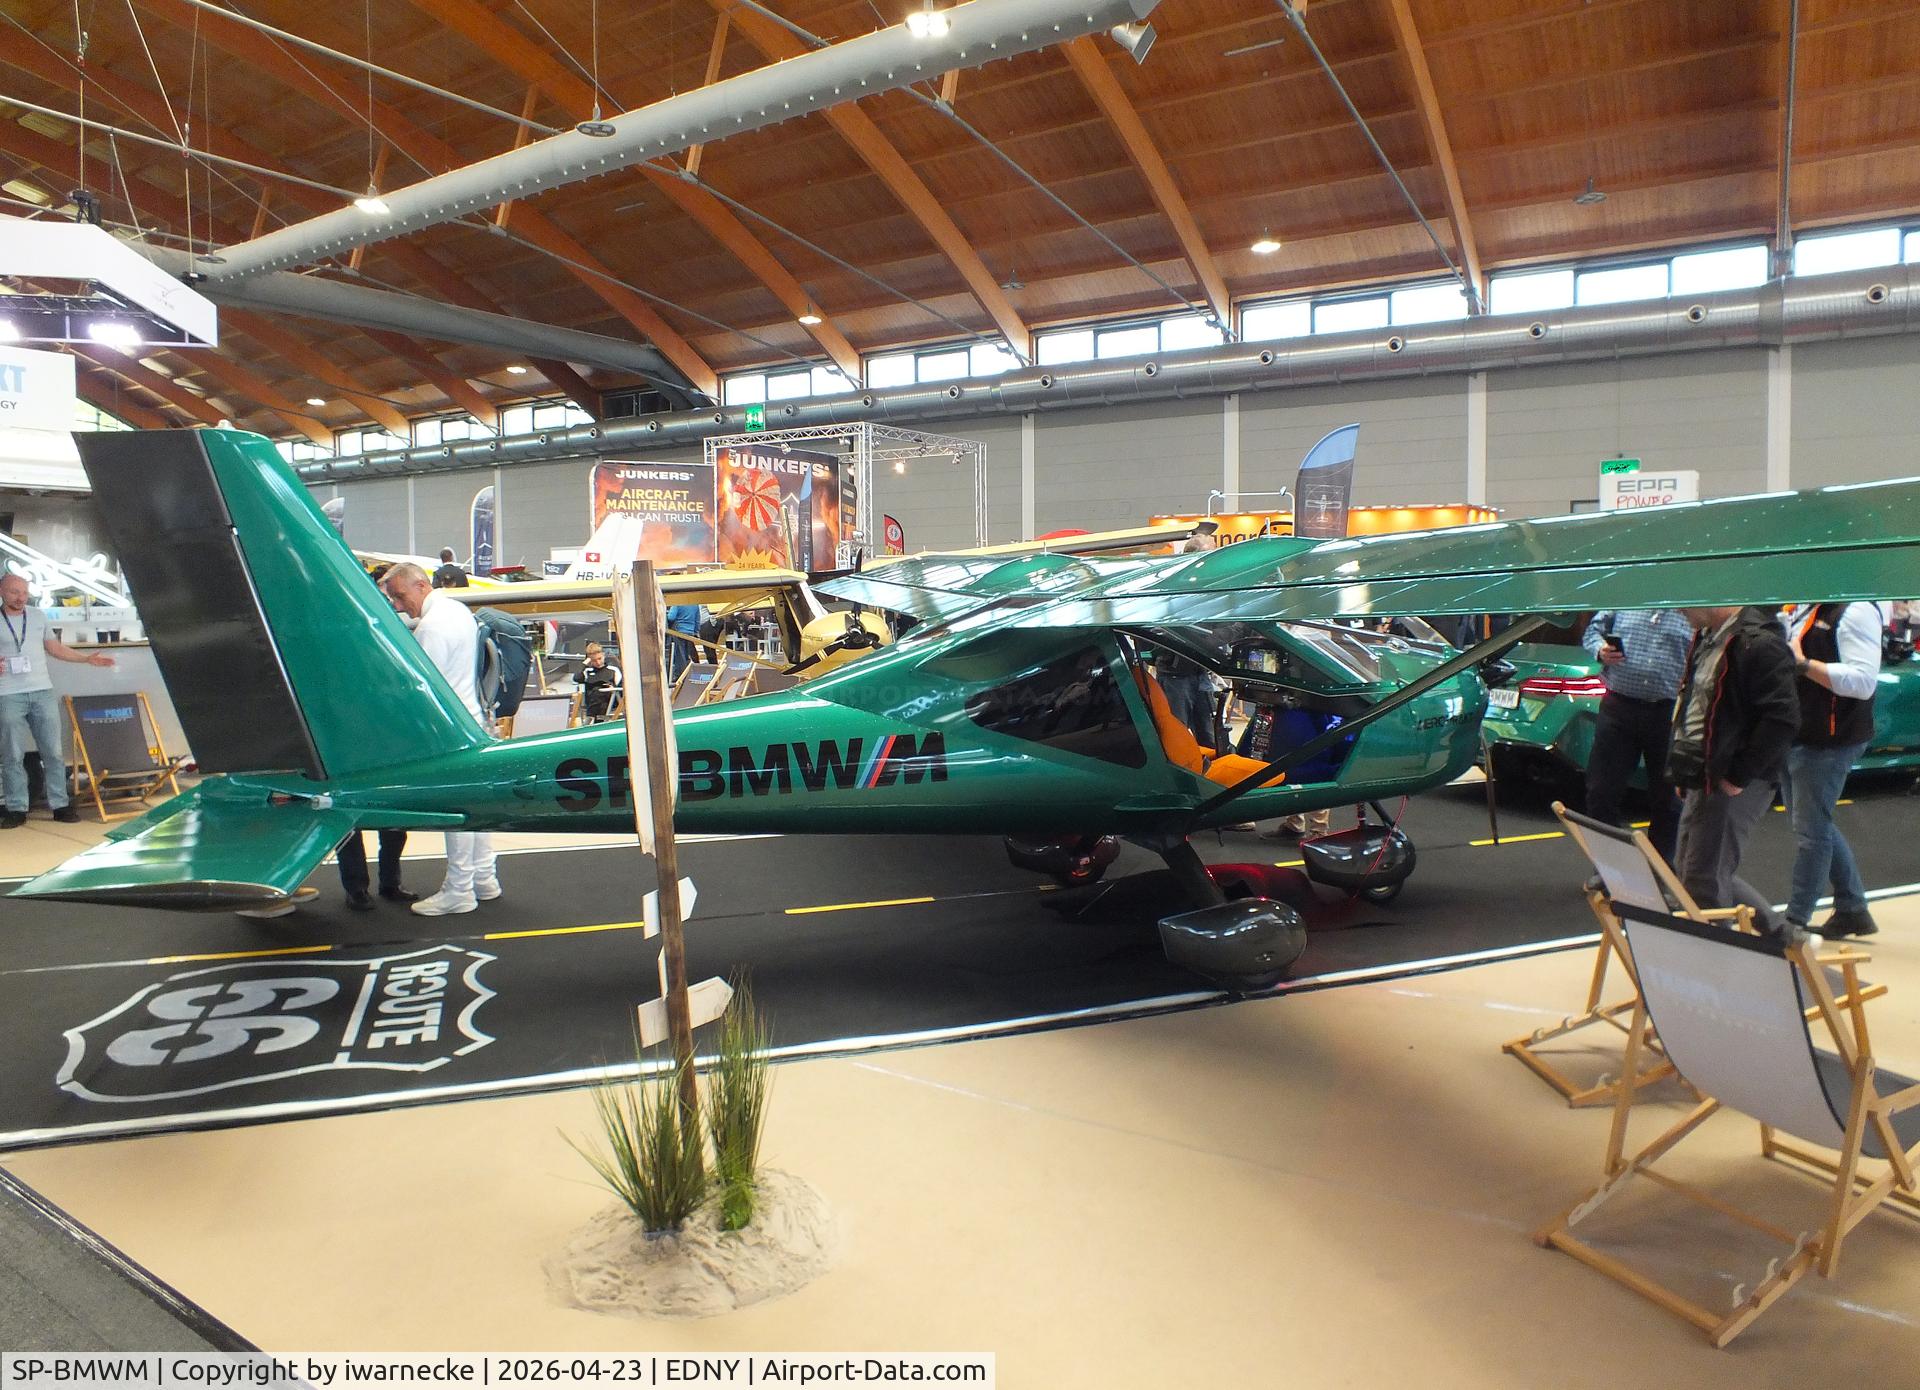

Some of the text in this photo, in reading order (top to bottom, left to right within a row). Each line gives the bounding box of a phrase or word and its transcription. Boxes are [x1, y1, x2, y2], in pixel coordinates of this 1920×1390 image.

[1616, 477, 1678, 493] EPA
[620, 488, 690, 501] AIRCRAFT
[605, 499, 705, 512] MAINTENANCE
[636, 512, 662, 523] CAN
[664, 512, 701, 524] TRUST!
[366, 960, 450, 1049] ROUTE
[105, 976, 340, 1067] 66
